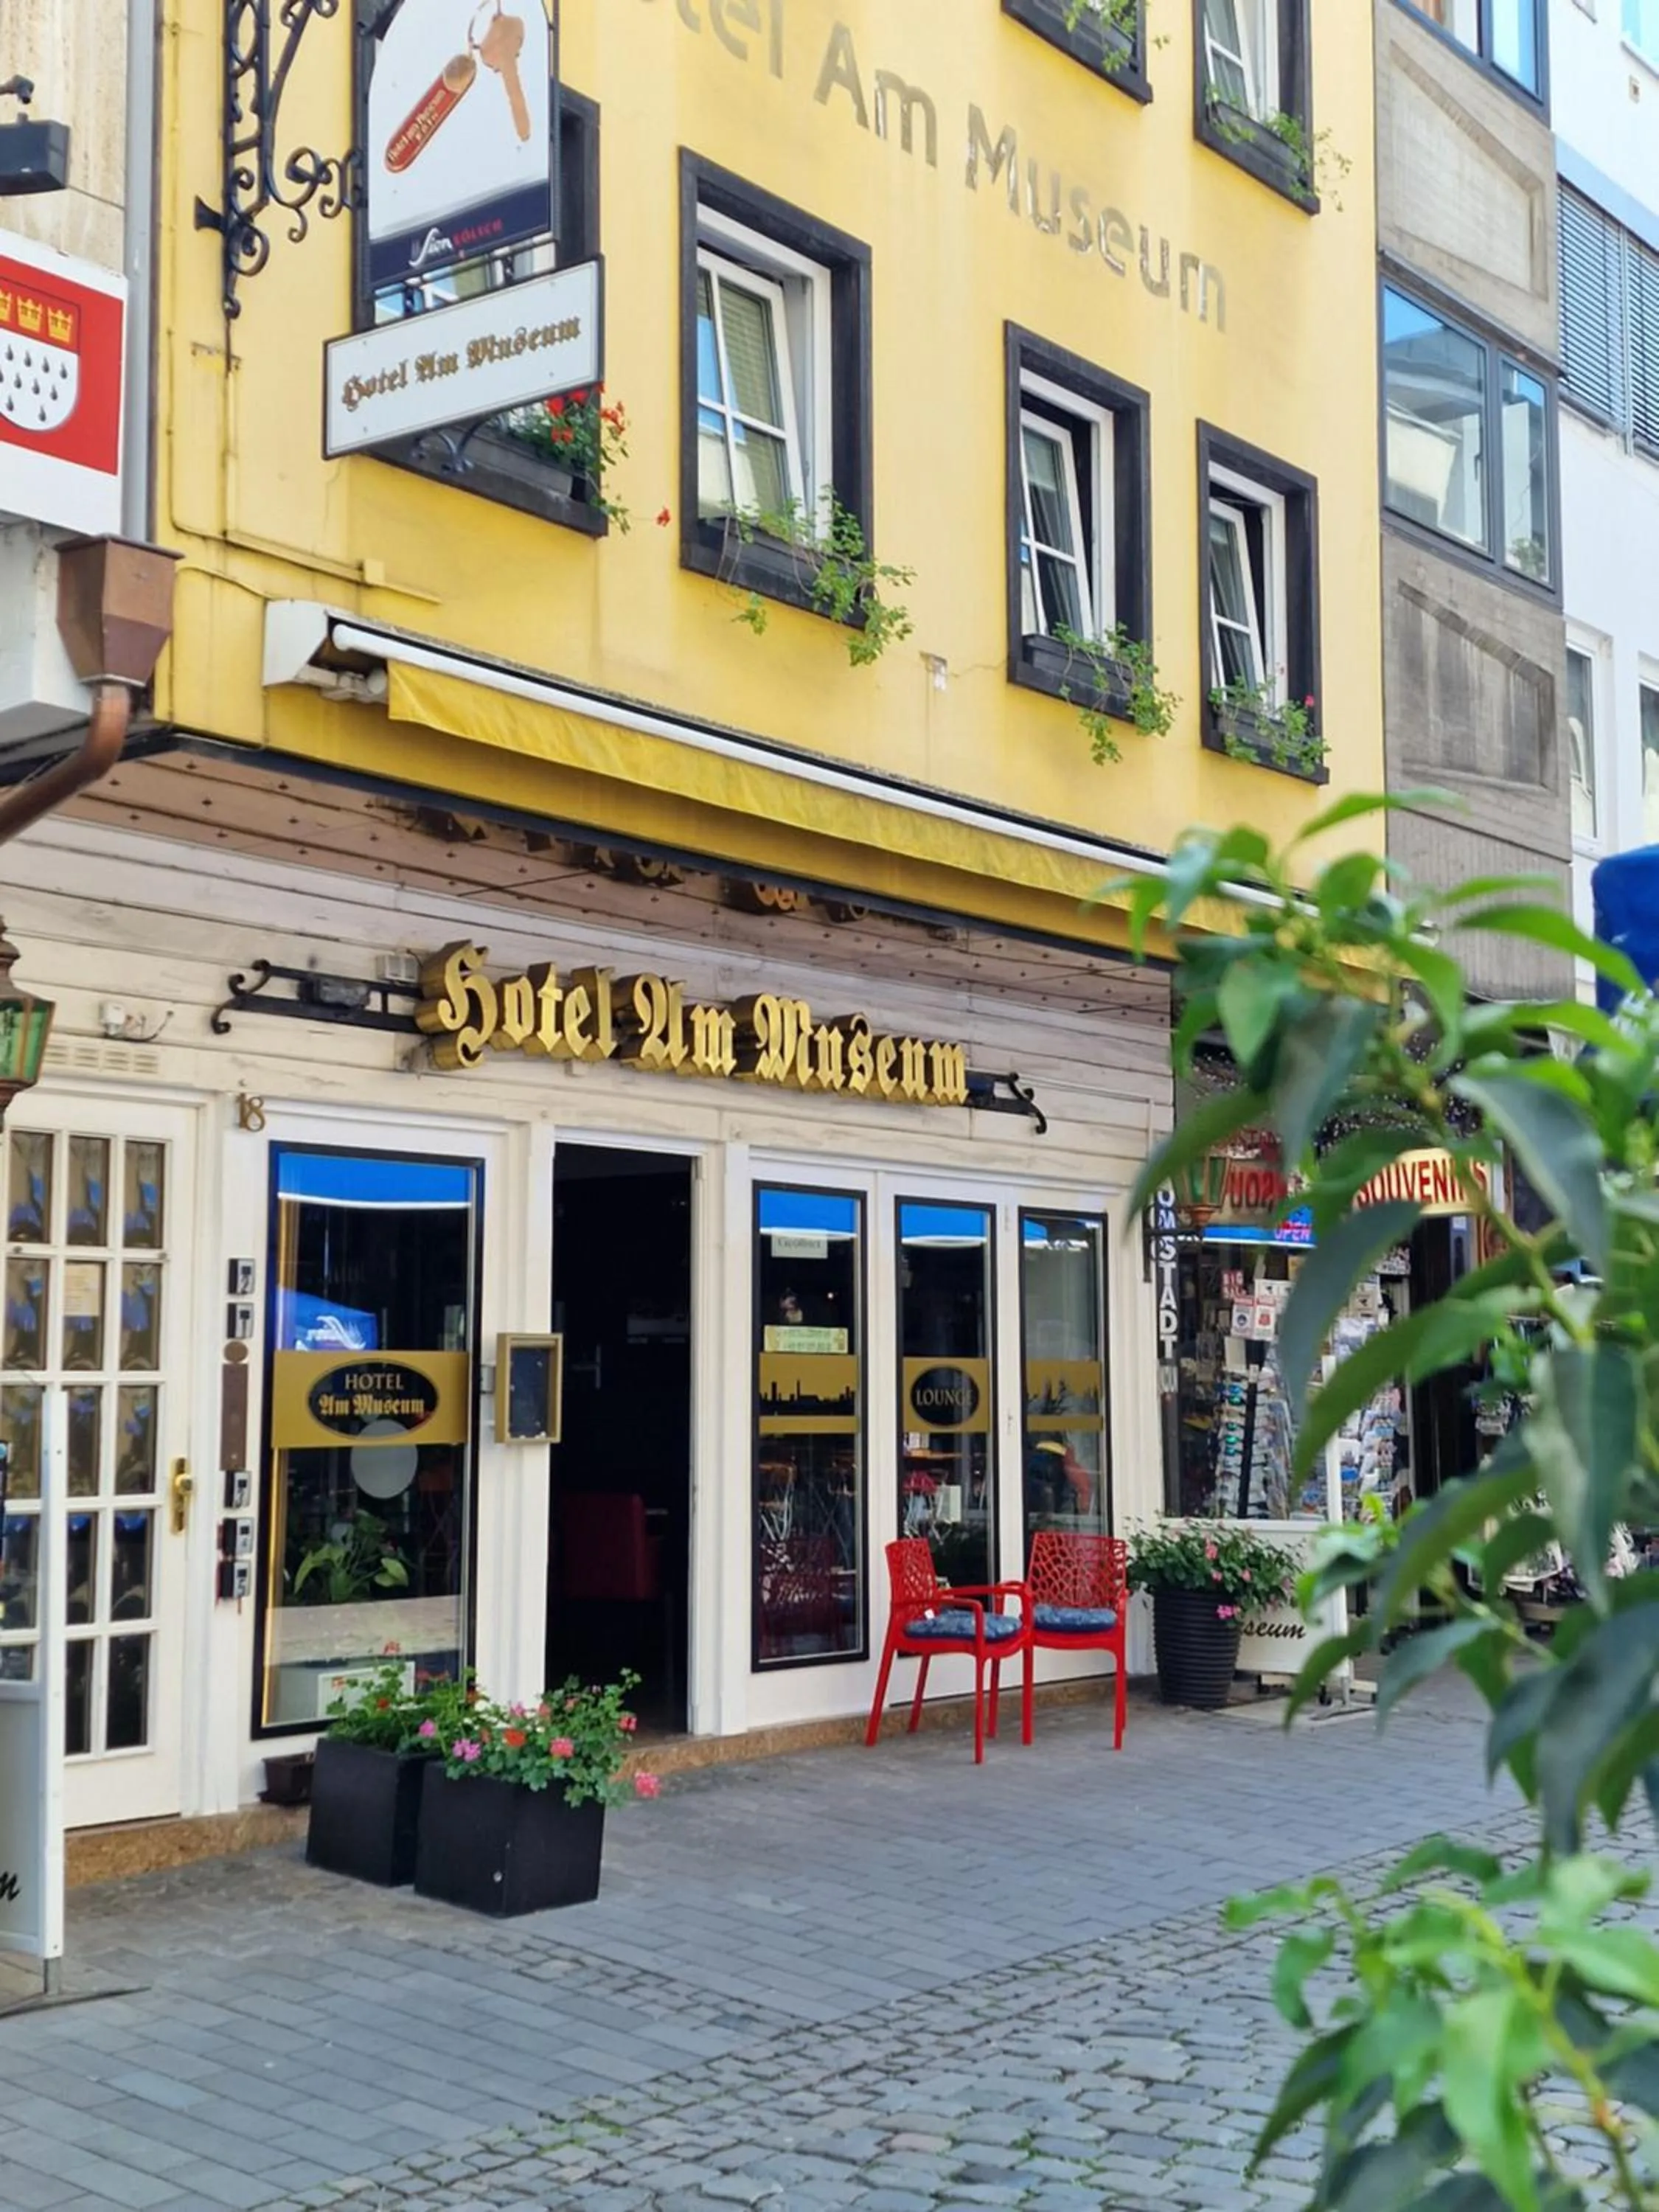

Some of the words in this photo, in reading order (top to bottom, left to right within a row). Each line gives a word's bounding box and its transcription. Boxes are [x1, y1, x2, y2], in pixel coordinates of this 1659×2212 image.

[813, 21, 937, 168] Am
[964, 102, 1227, 333] Museum
[341, 358, 408, 412] Hotel
[415, 350, 459, 383] Am
[466, 316, 581, 369] Museum
[438, 943, 618, 1069] Hotel
[635, 973, 737, 1077] Am
[754, 992, 970, 1105] Museum
[235, 1093, 265, 1133] 18
[1357, 1157, 1488, 1210] SOUVENIS
[1158, 1177, 1178, 1359] OMSTADT
[319, 1394, 350, 1415] Am
[352, 1394, 425, 1415] Museum
[344, 1373, 404, 1390] HOTEL
[916, 1389, 973, 1406] LOUNGE
[1243, 1620, 1306, 1639] seum
